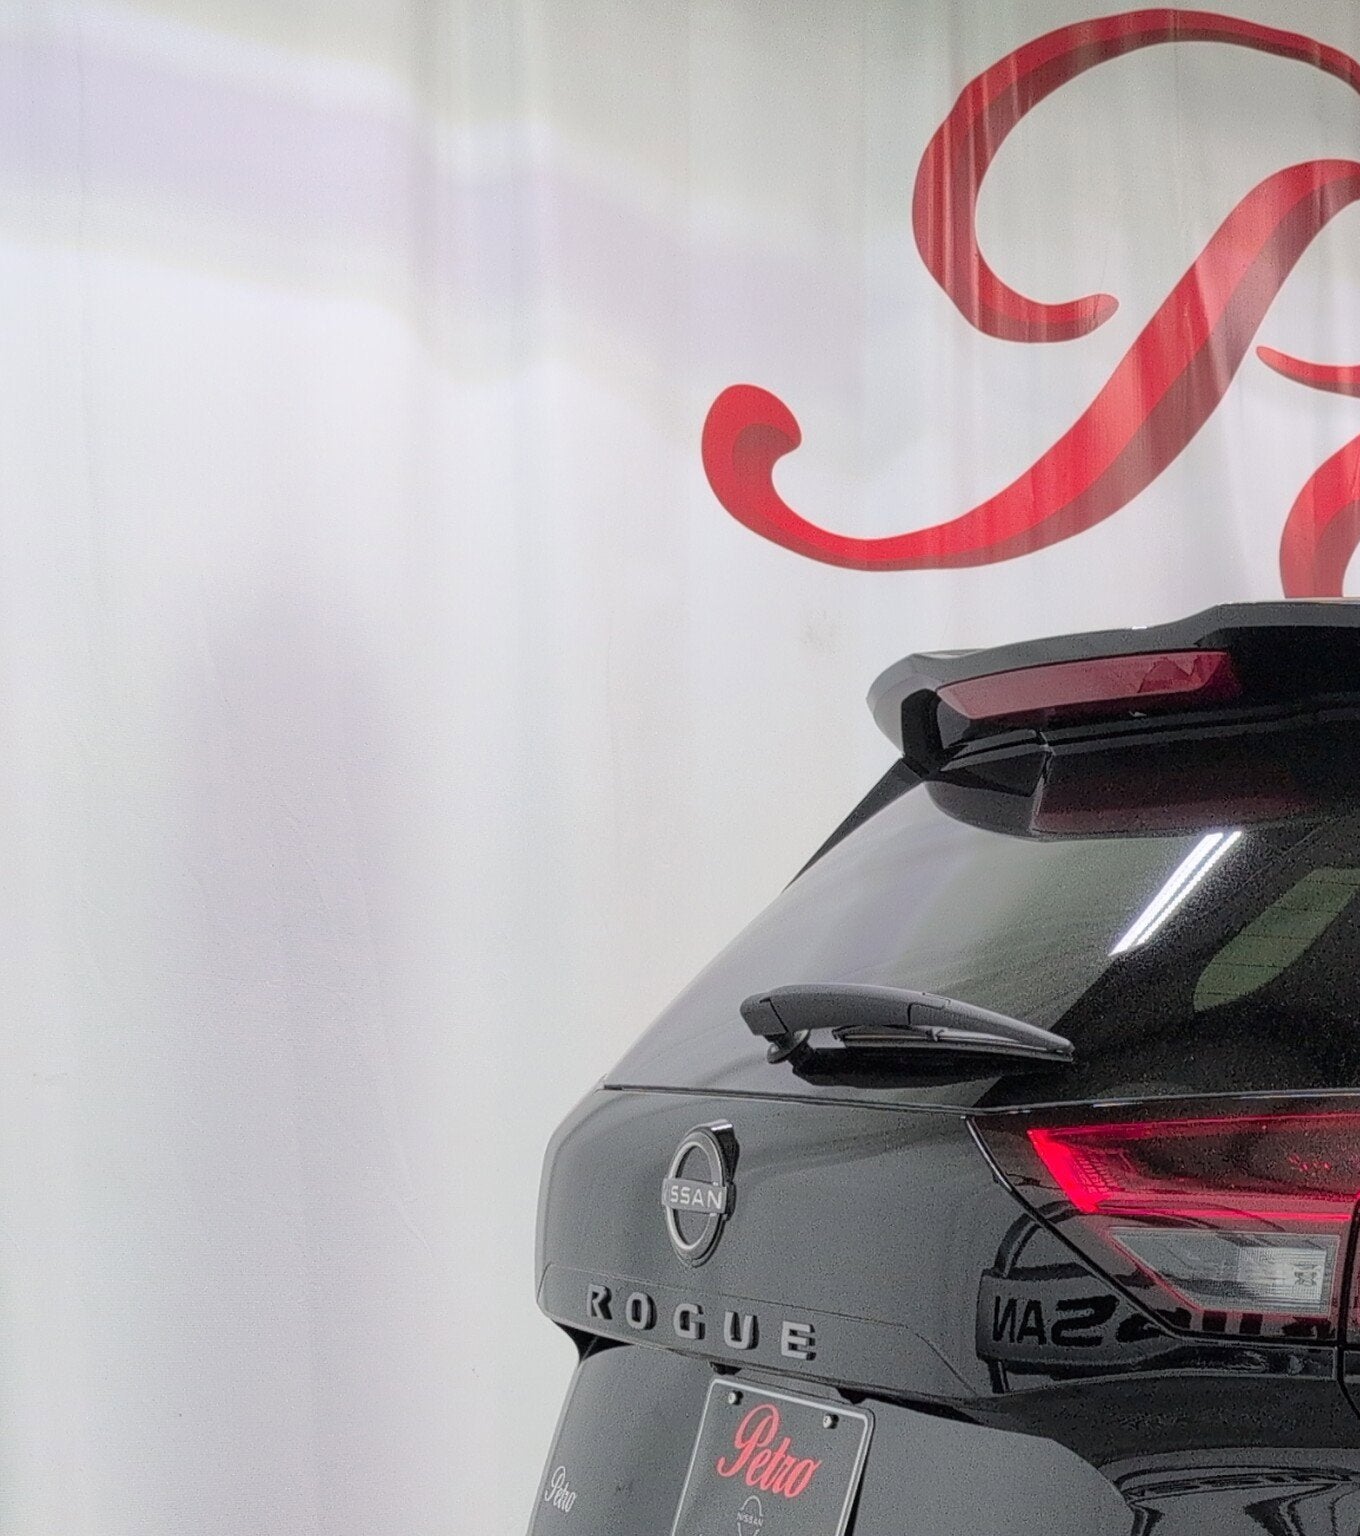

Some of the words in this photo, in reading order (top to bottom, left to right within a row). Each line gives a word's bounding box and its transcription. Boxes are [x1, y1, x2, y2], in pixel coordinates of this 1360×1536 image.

[586, 1284, 816, 1360] ROGUE
[544, 1465, 576, 1512] Petro
[716, 1403, 822, 1498] Petro
